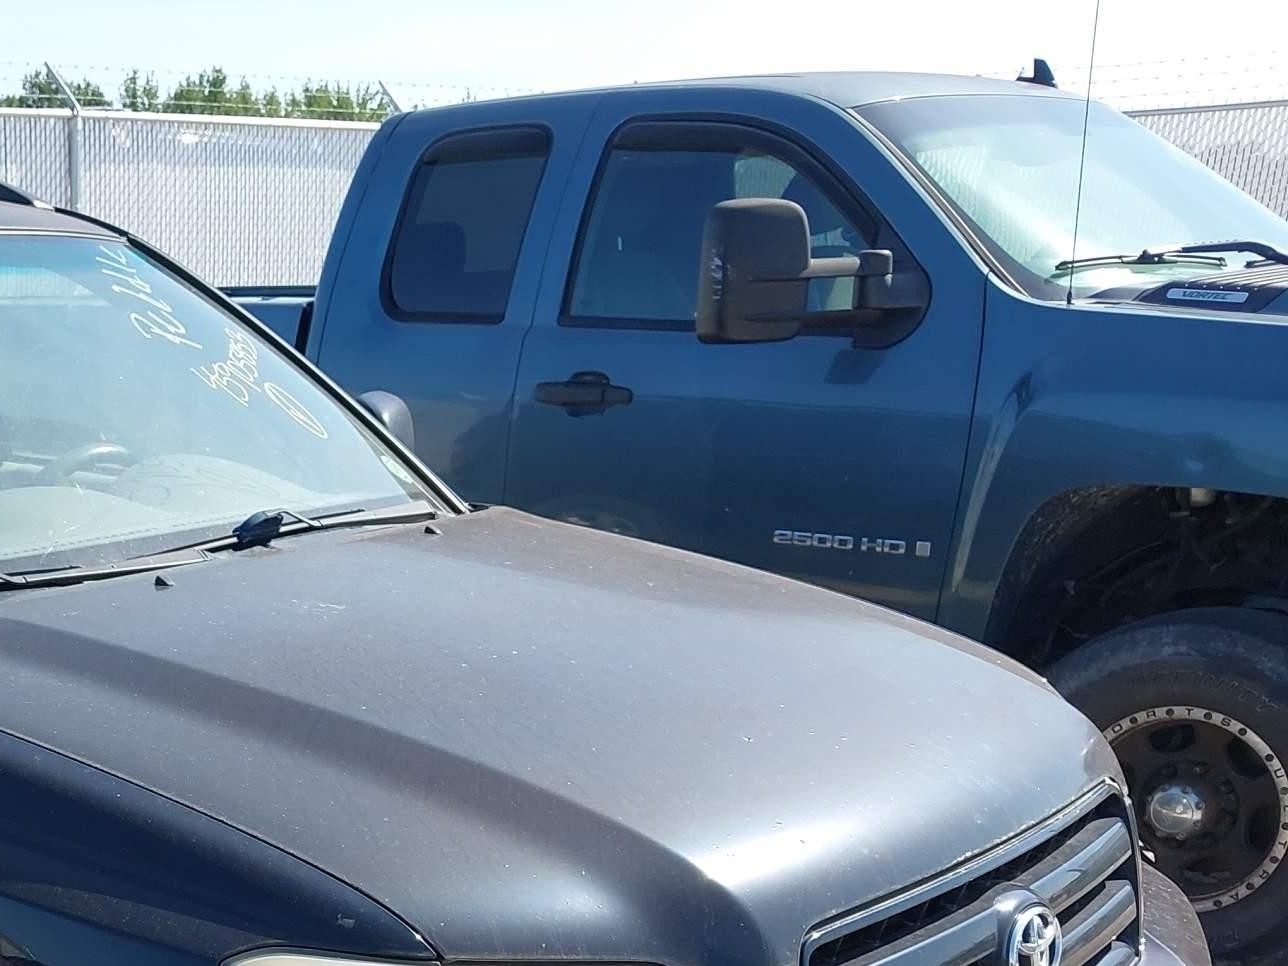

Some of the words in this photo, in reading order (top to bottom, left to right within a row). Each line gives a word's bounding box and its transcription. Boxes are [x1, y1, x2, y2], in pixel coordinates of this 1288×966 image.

[1181, 290, 1231, 301] VORTEC
[772, 529, 854, 550] 2500
[860, 537, 907, 555] HD
